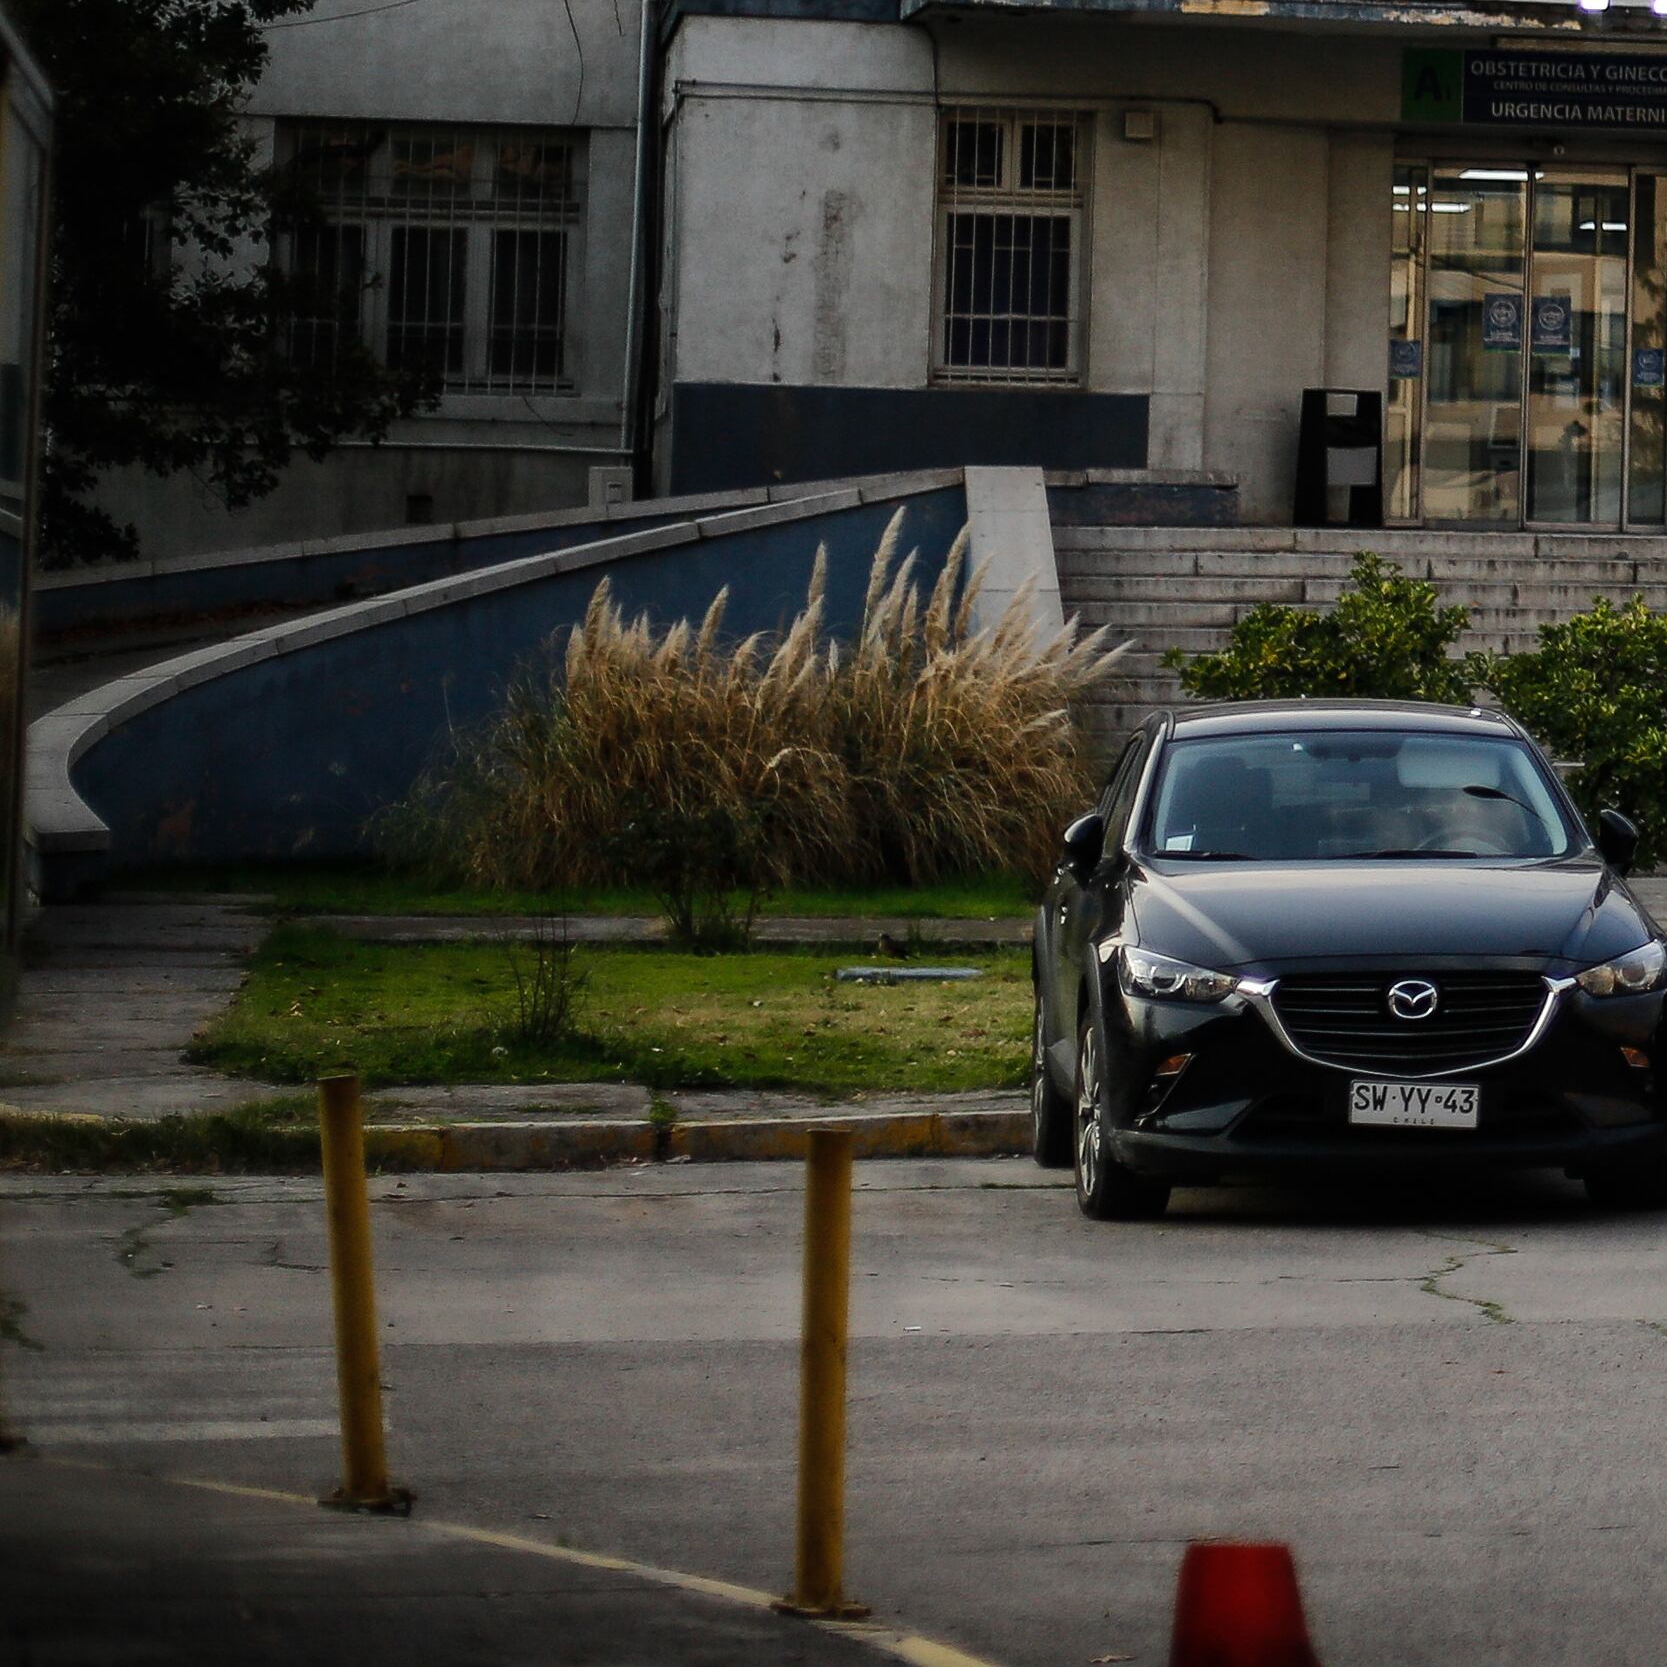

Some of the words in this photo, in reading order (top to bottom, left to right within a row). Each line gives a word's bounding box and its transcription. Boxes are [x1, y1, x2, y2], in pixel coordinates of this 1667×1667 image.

[1470, 60, 1588, 80] OBSTETRICIA
[1591, 65, 1601, 81] Y
[1493, 80, 1534, 92] CENTRO
[1535, 82, 1548, 92] DE
[1550, 82, 1606, 94] CONSULTAS
[1491, 102, 1583, 121] URGENCIA
[1392, 1116, 1435, 1125] CHILE
